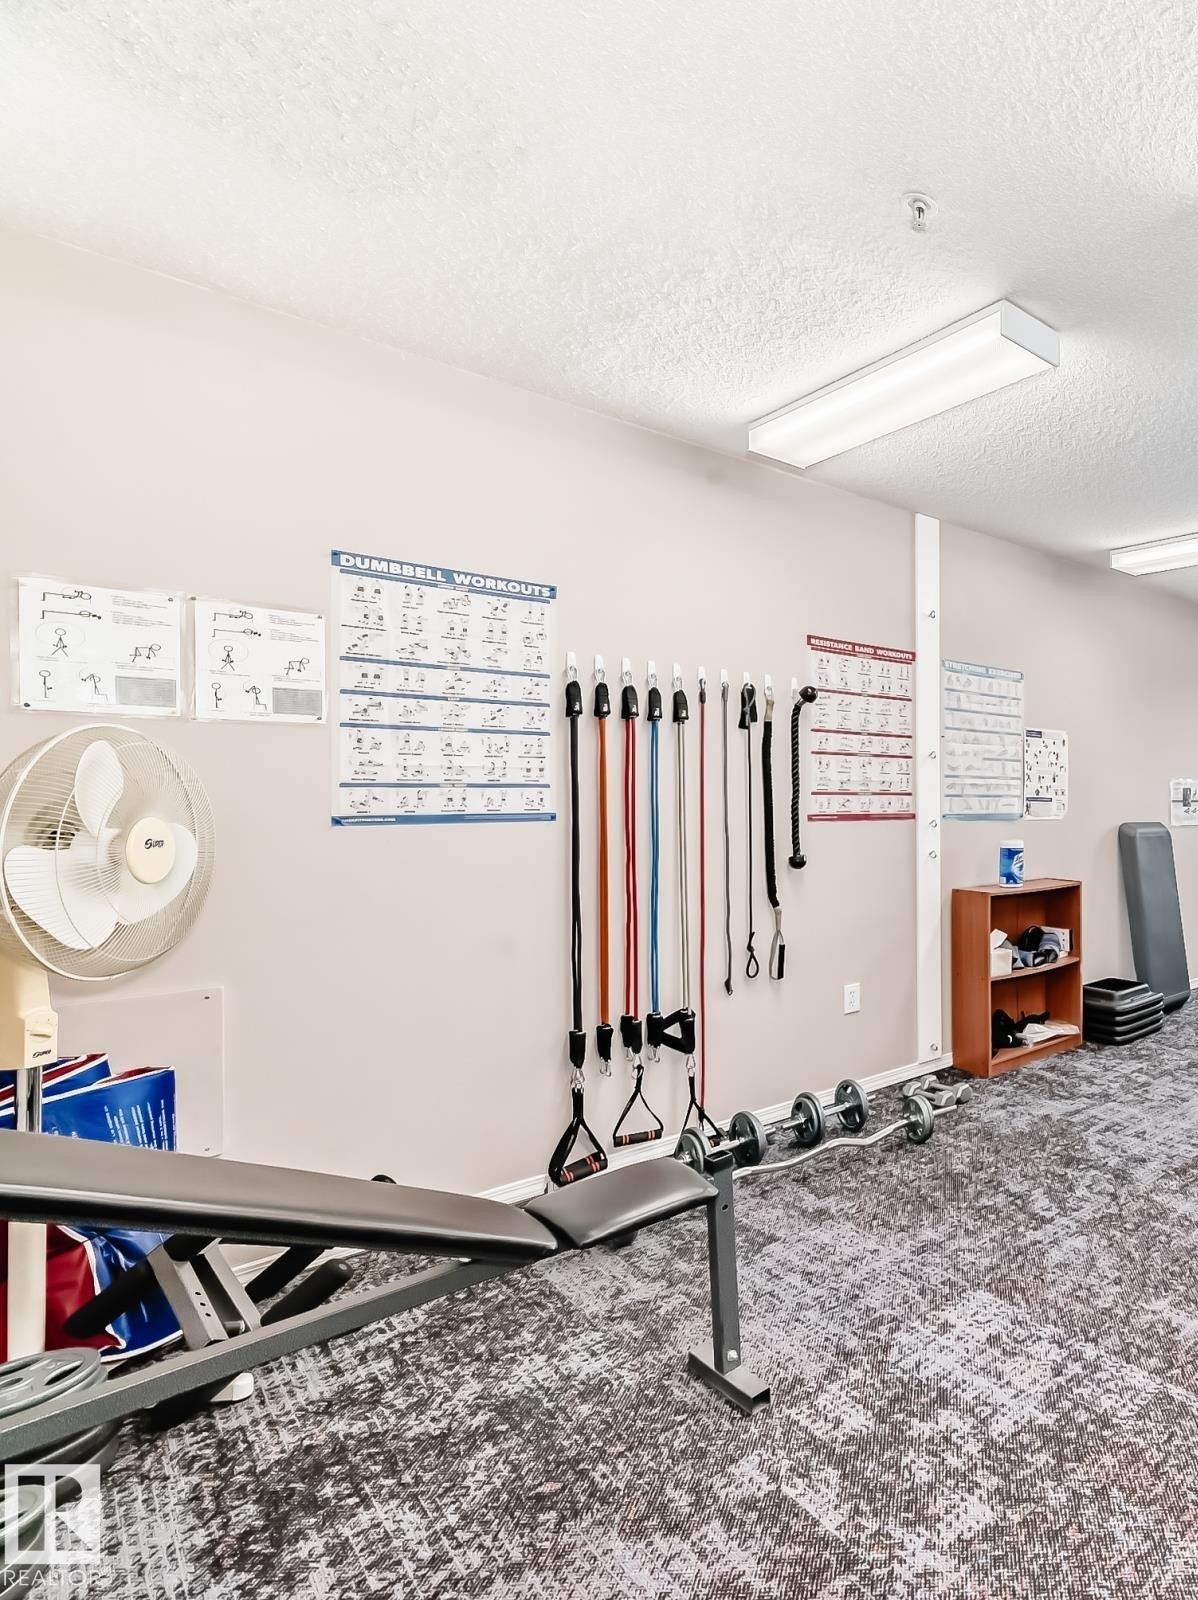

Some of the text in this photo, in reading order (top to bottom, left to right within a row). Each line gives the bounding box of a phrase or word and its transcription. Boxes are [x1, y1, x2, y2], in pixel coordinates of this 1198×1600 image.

[340, 553, 551, 597] DUMBBELL WORKOUTS
[810, 638, 852, 651] RESISTANCE
[854, 645, 875, 654] BAND
[876, 648, 913, 660] WORKOUTS
